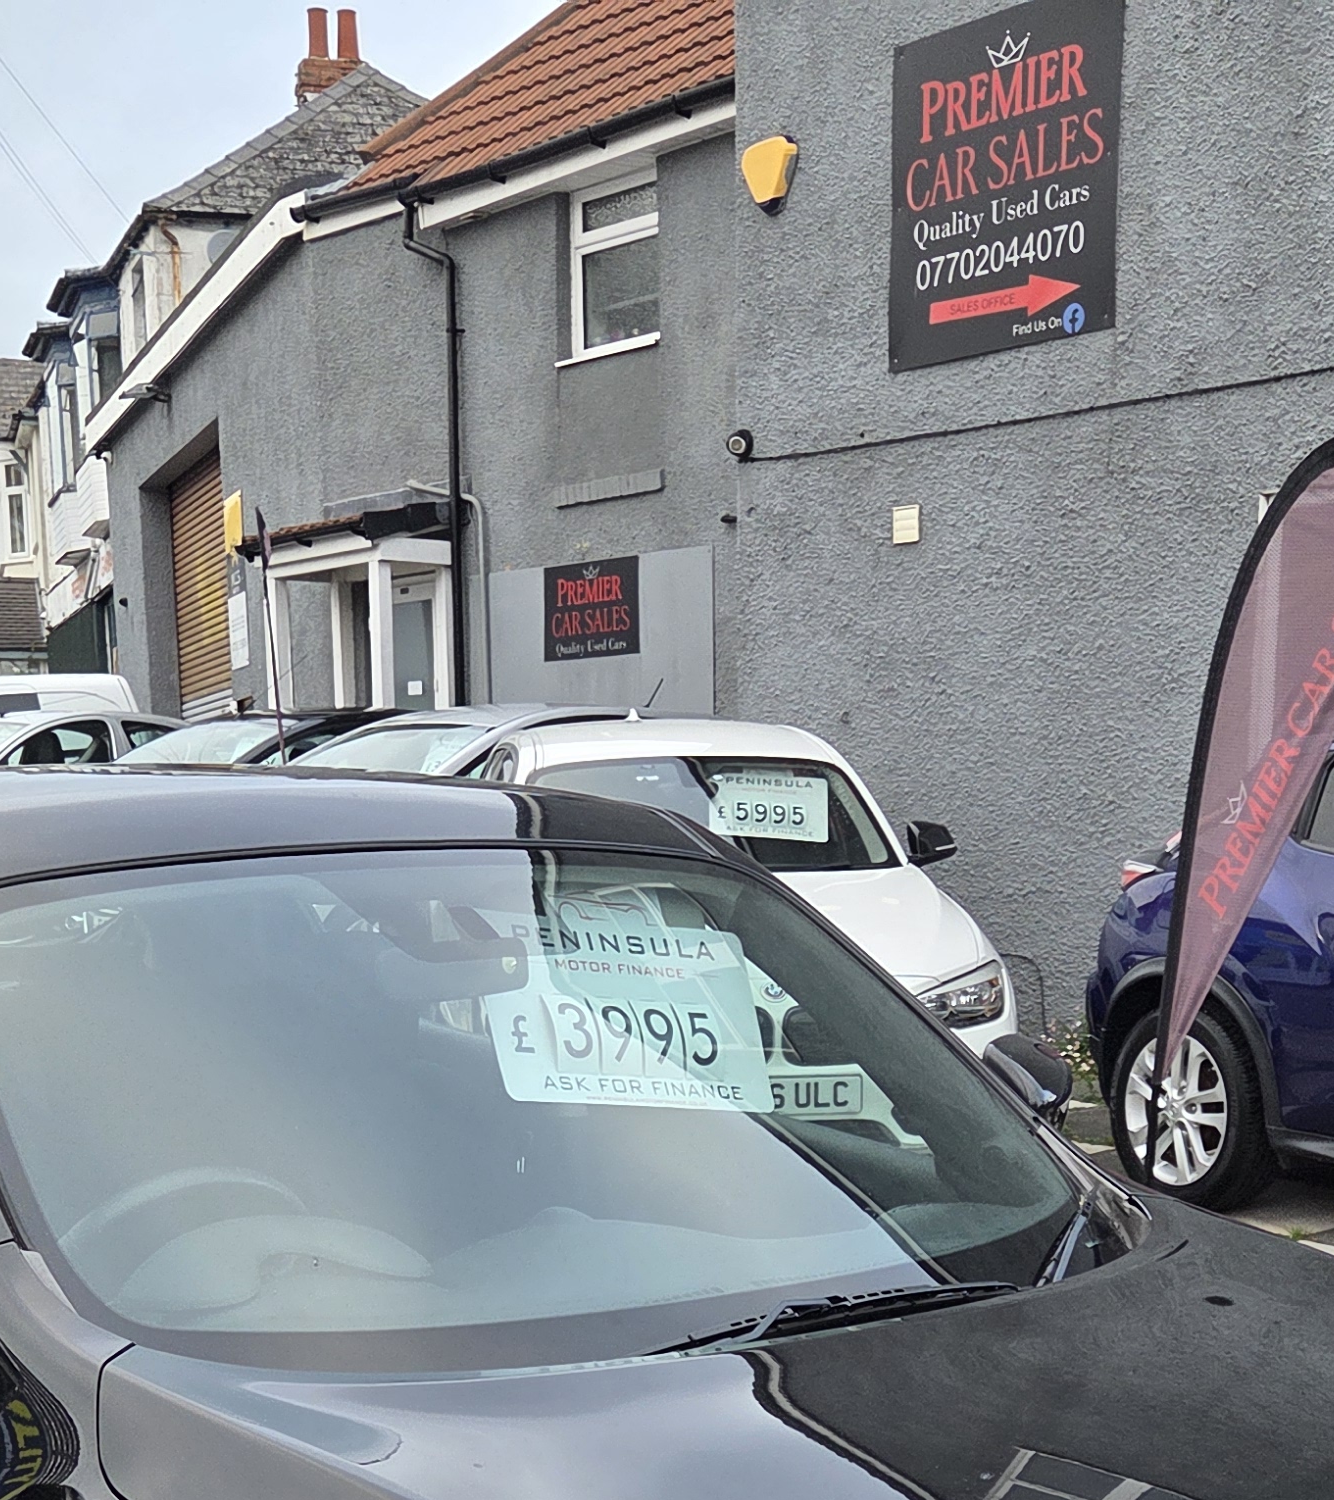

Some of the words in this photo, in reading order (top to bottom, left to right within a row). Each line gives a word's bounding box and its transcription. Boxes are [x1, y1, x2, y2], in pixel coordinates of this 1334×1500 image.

[920, 44, 1087, 144] PREMIER
[906, 146, 979, 211] CAR
[987, 108, 1104, 190] SALES
[913, 211, 984, 250] Quality
[991, 189, 1038, 225] Used
[1045, 184, 1090, 211] Cars
[916, 220, 1085, 291] 07702044070
[950, 300, 979, 315] SALES
[981, 293, 1015, 309] OFFICE
[1013, 322, 1032, 337] Find
[1034, 320, 1046, 333] Us
[1048, 317, 1062, 329] On
[556, 575, 623, 607] PREMIER
[552, 611, 582, 638] CAR
[584, 605, 631, 634] SALES
[555, 641, 585, 658] Quality
[608, 637, 627, 650] Cars
[725, 776, 813, 788] PENINSULA
[1199, 738, 1300, 920] PREMIER
[511, 924, 715, 961] PENINSULA
[554, 958, 612, 974] MOTOR
[618, 963, 685, 980] FINANCE
[544, 1075, 591, 1092] ASK
[598, 1078, 644, 1095] FOR
[652, 1081, 745, 1101] FINANCE
[795, 1081, 849, 1108] ULC
